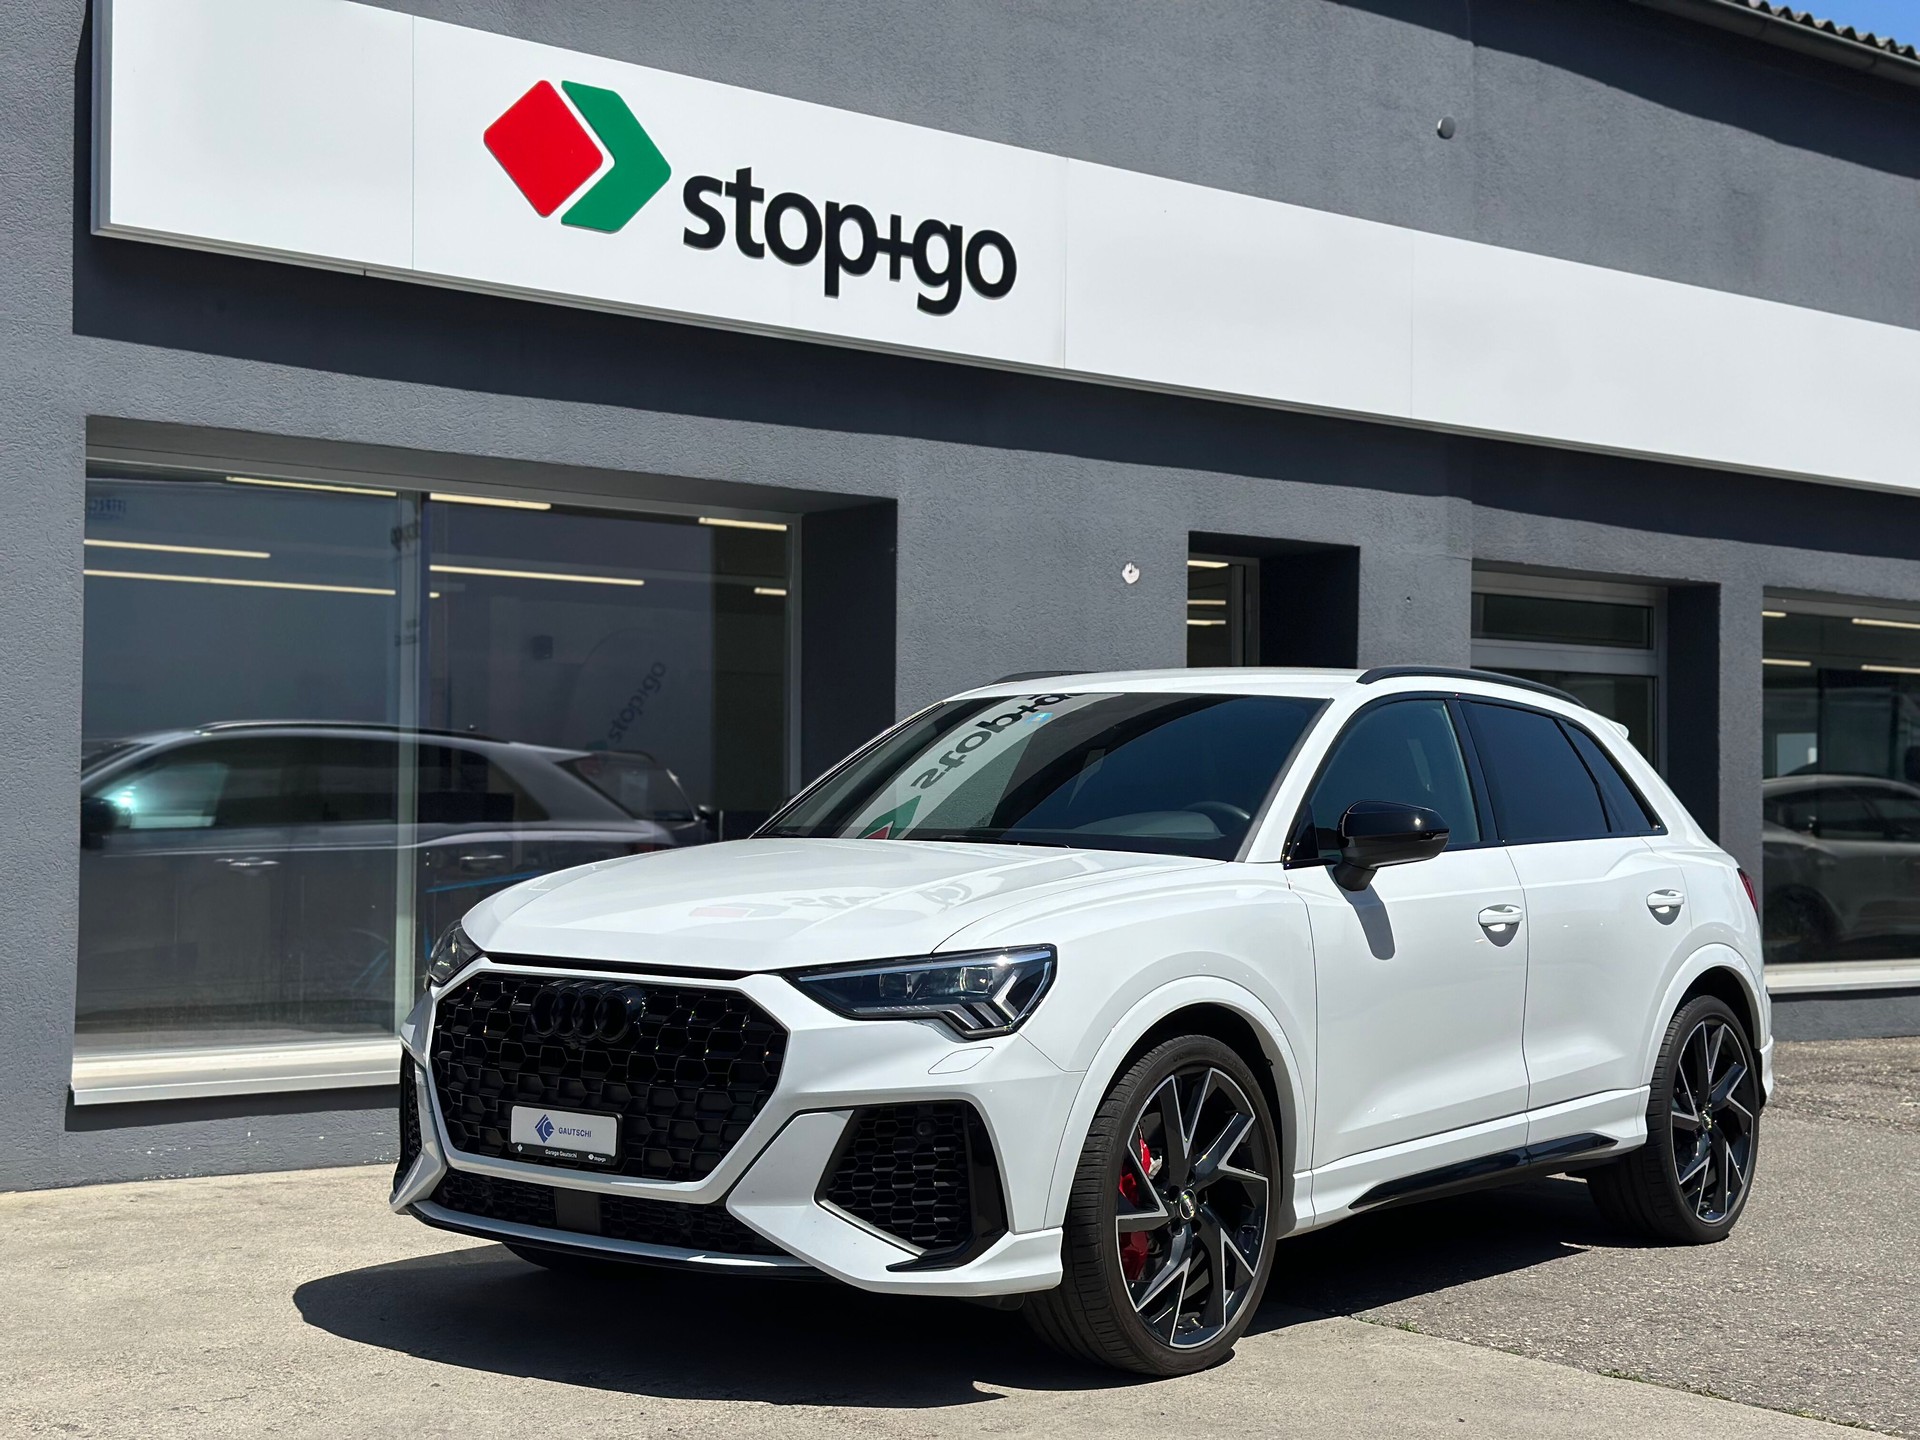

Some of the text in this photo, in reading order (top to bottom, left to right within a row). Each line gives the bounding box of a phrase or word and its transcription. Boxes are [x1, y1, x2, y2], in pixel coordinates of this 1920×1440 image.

[683, 167, 1017, 316] stop+go
[558, 1127, 592, 1138] GAUTSCHI
[545, 1149, 560, 1157] Garage
